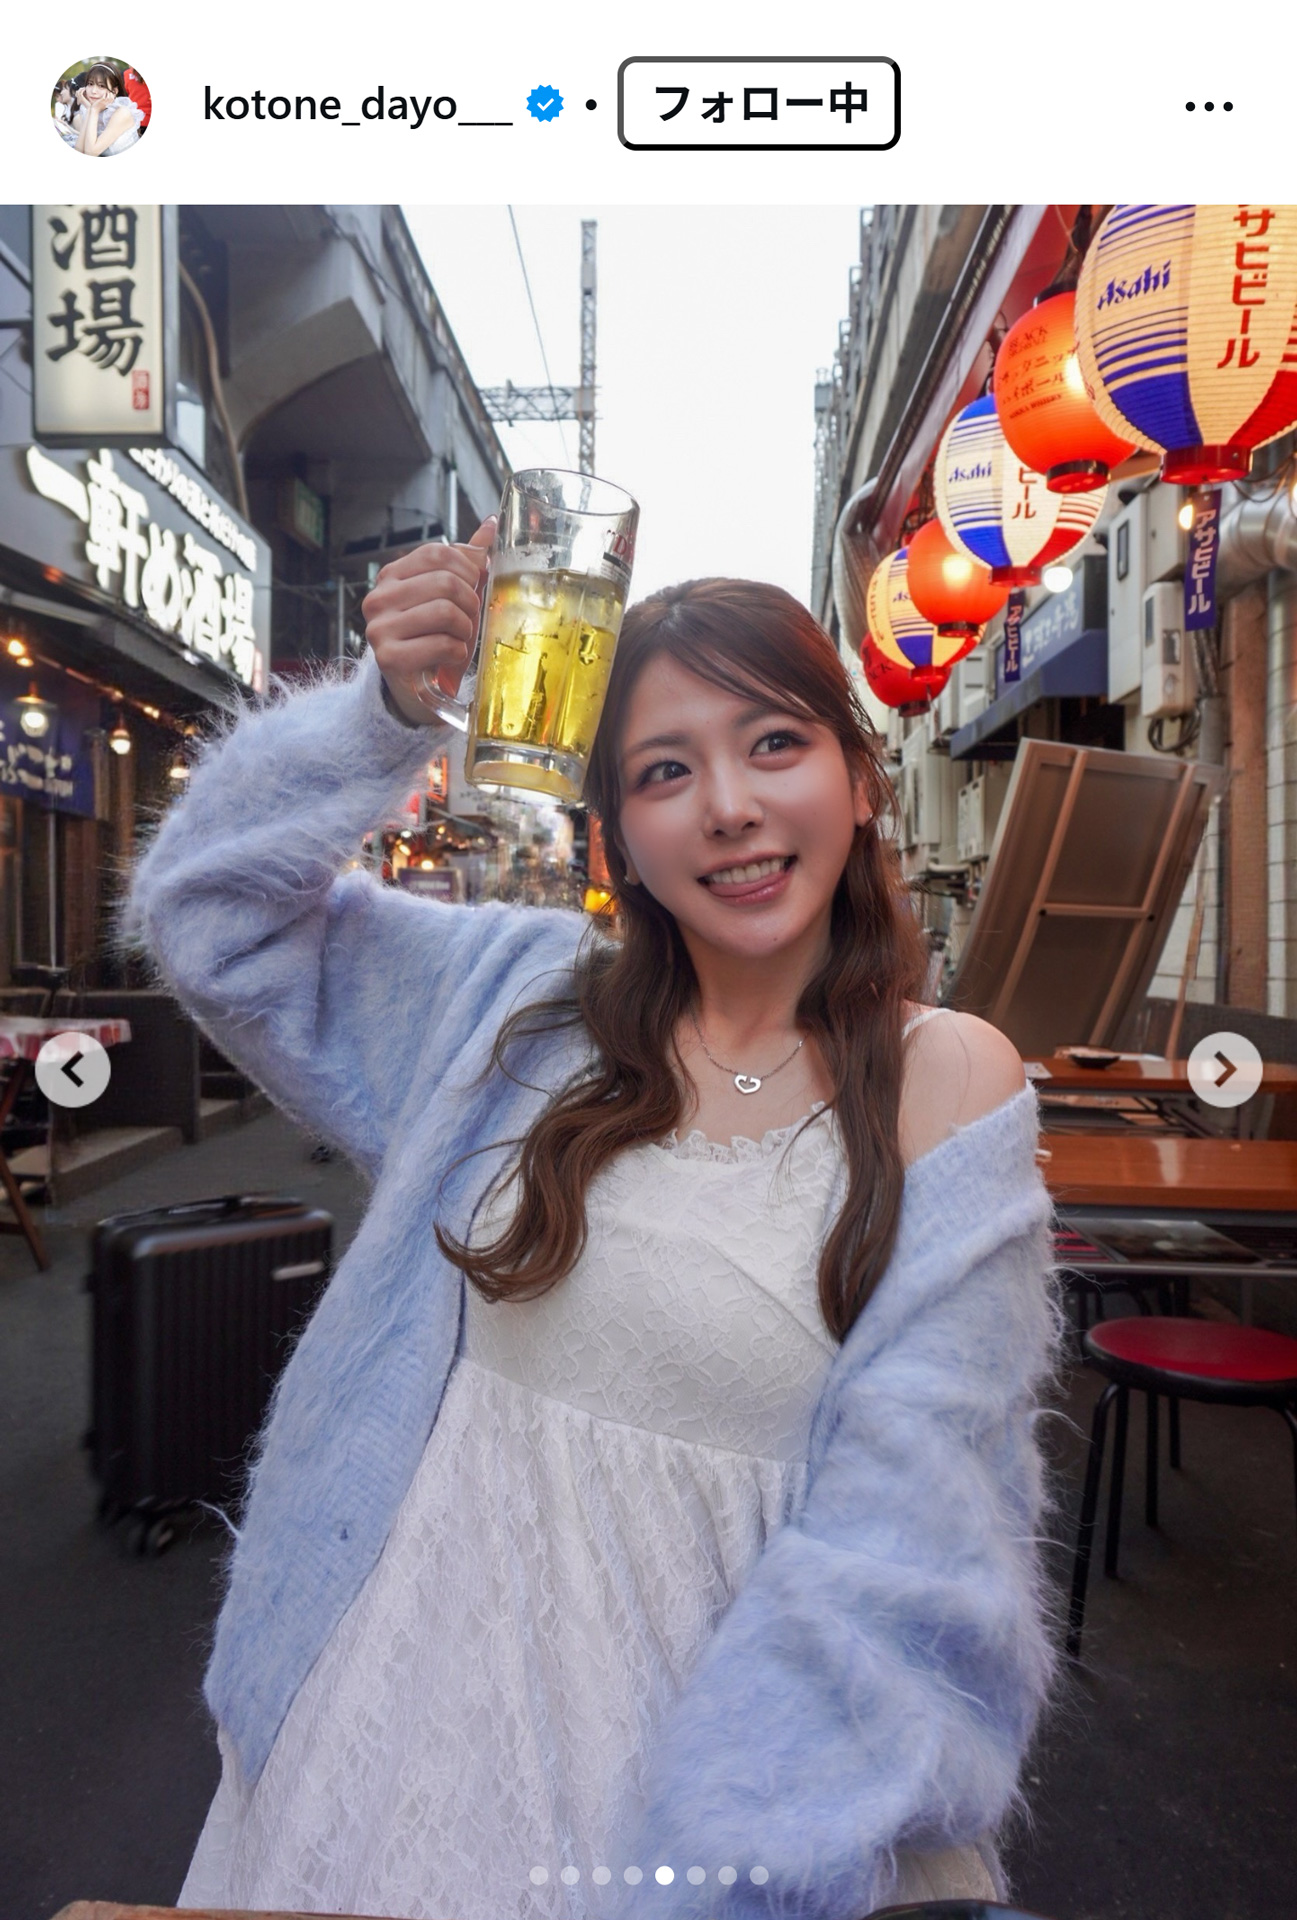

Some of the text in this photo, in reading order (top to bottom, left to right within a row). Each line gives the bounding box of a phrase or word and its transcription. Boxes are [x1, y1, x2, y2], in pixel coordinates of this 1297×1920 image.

[46, 205, 144, 377] 酒場
[1097, 260, 1171, 310] Asahi
[1217, 205, 1275, 369] サヒビール
[949, 461, 993, 484] Asahi
[27, 446, 258, 685] 一軒め酒場
[1187, 508, 1217, 616] アサヒビール
